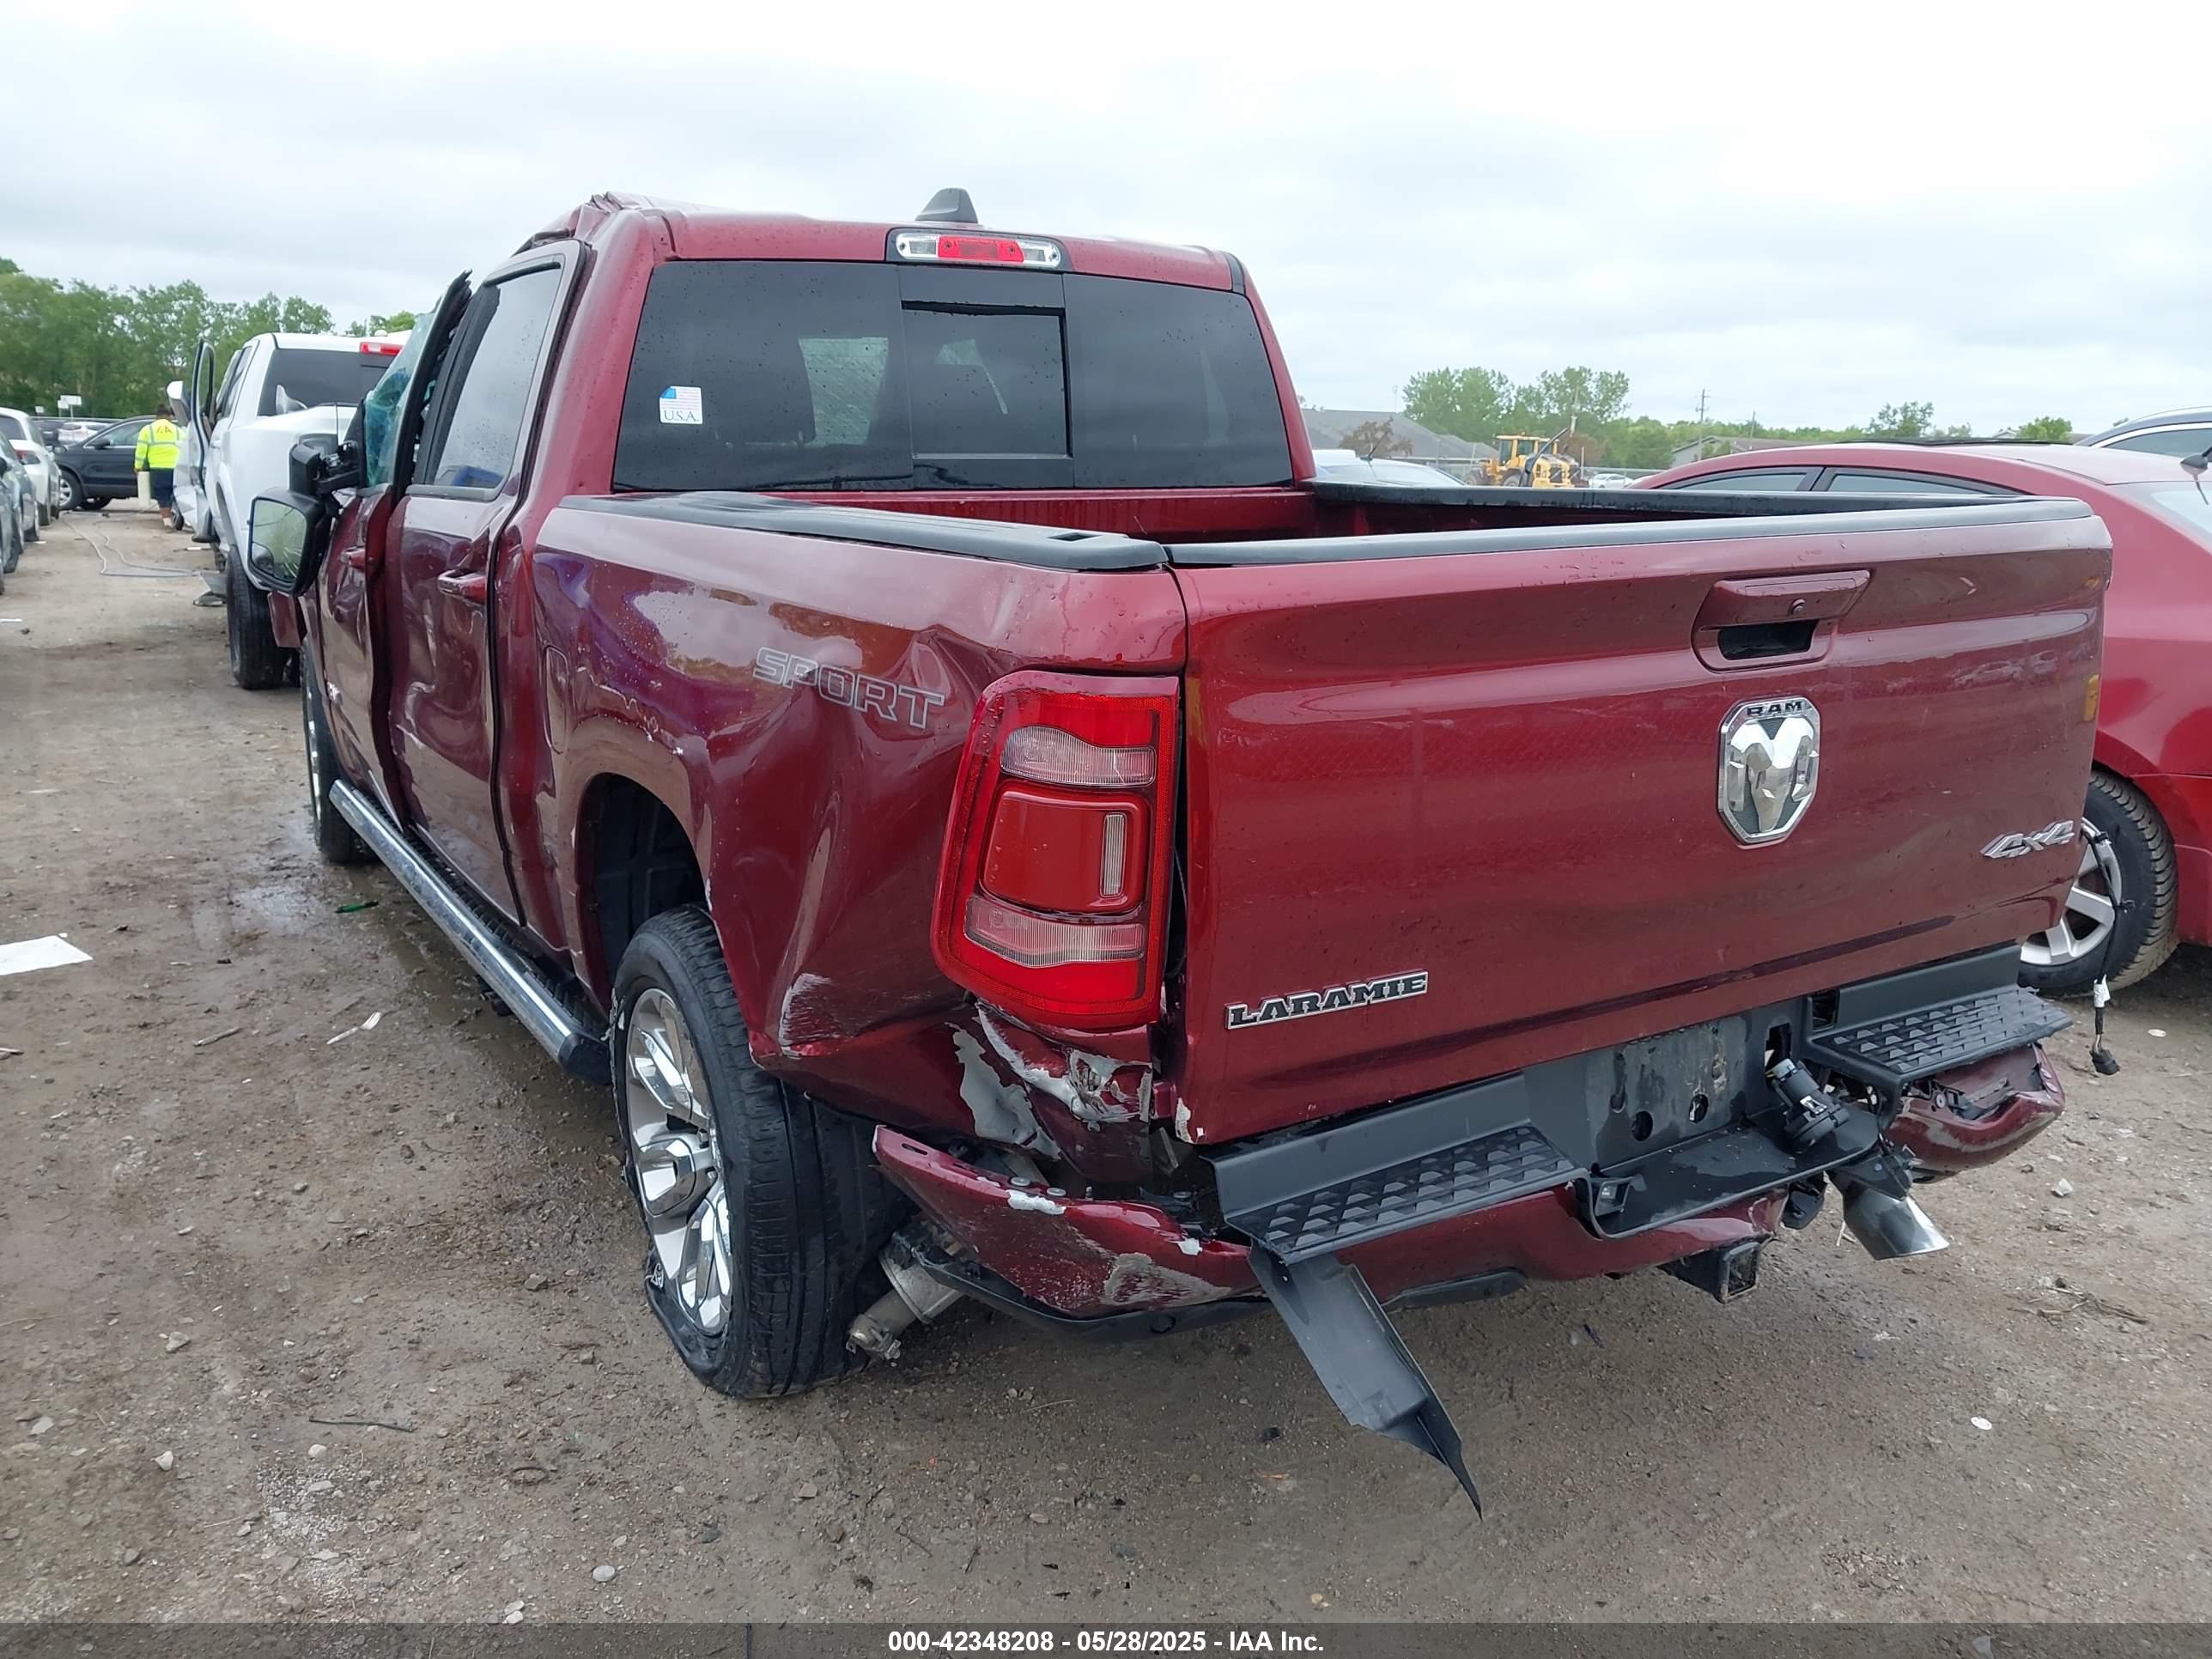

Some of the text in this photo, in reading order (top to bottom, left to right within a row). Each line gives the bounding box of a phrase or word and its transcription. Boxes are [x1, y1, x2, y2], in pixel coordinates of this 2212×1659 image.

[753, 647, 945, 729] SPORT
[1747, 701, 1802, 716] RAM
[1227, 970, 1429, 1030] LARAMIE
